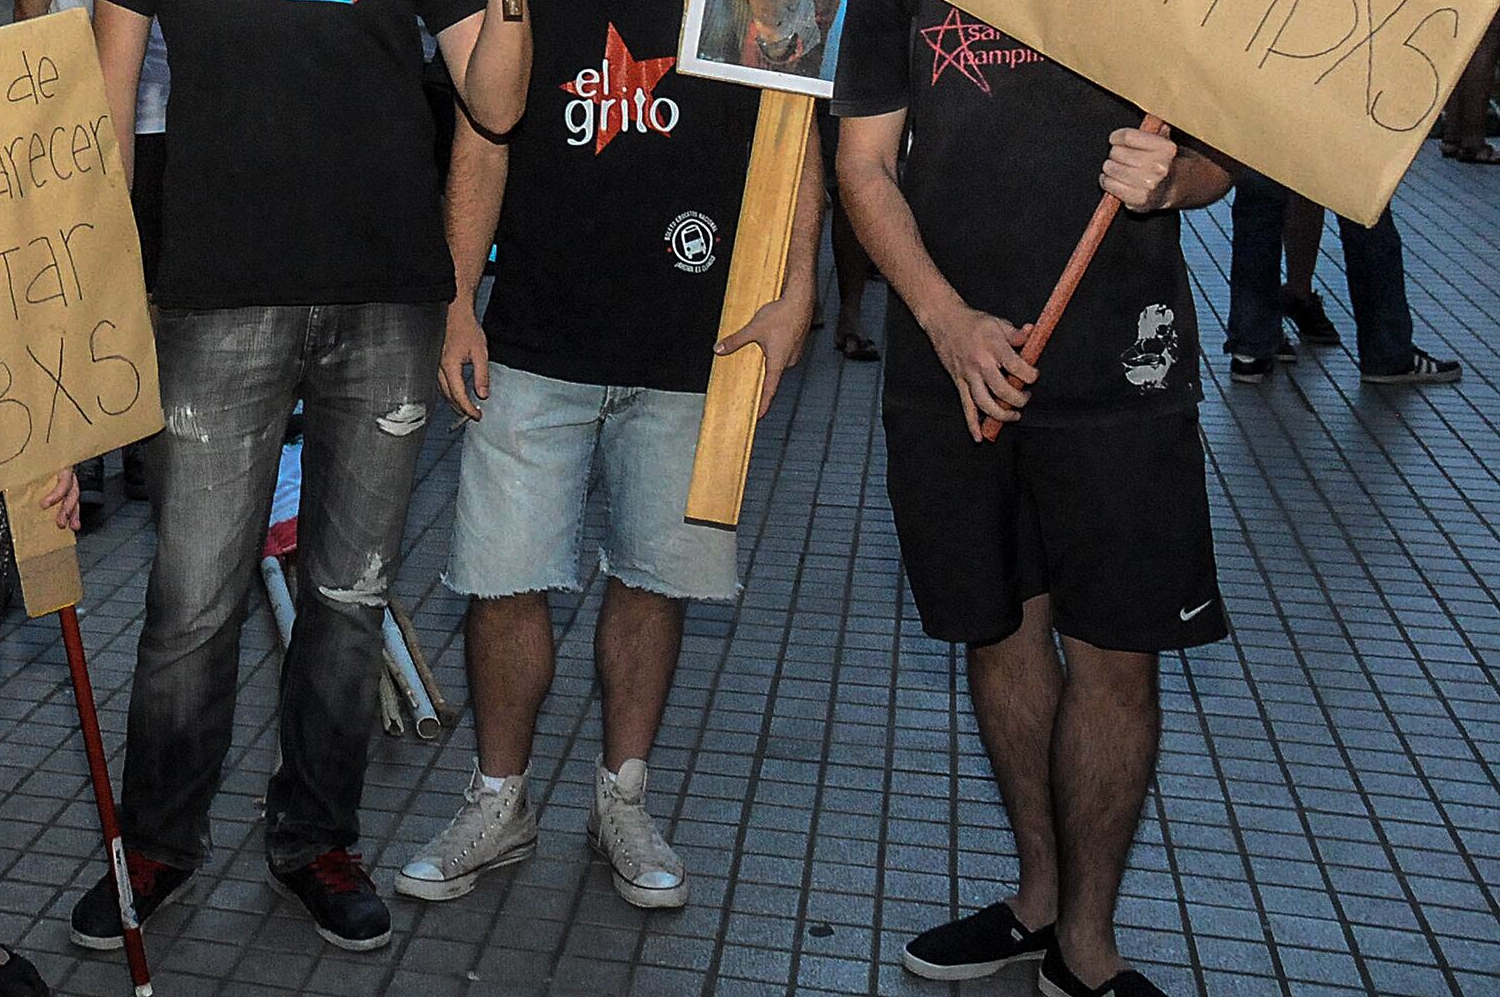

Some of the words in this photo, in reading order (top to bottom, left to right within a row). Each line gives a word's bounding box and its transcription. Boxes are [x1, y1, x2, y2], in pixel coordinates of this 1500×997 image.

[7, 50, 60, 105] de
[575, 58, 609, 98] el
[564, 87, 680, 146] grito
